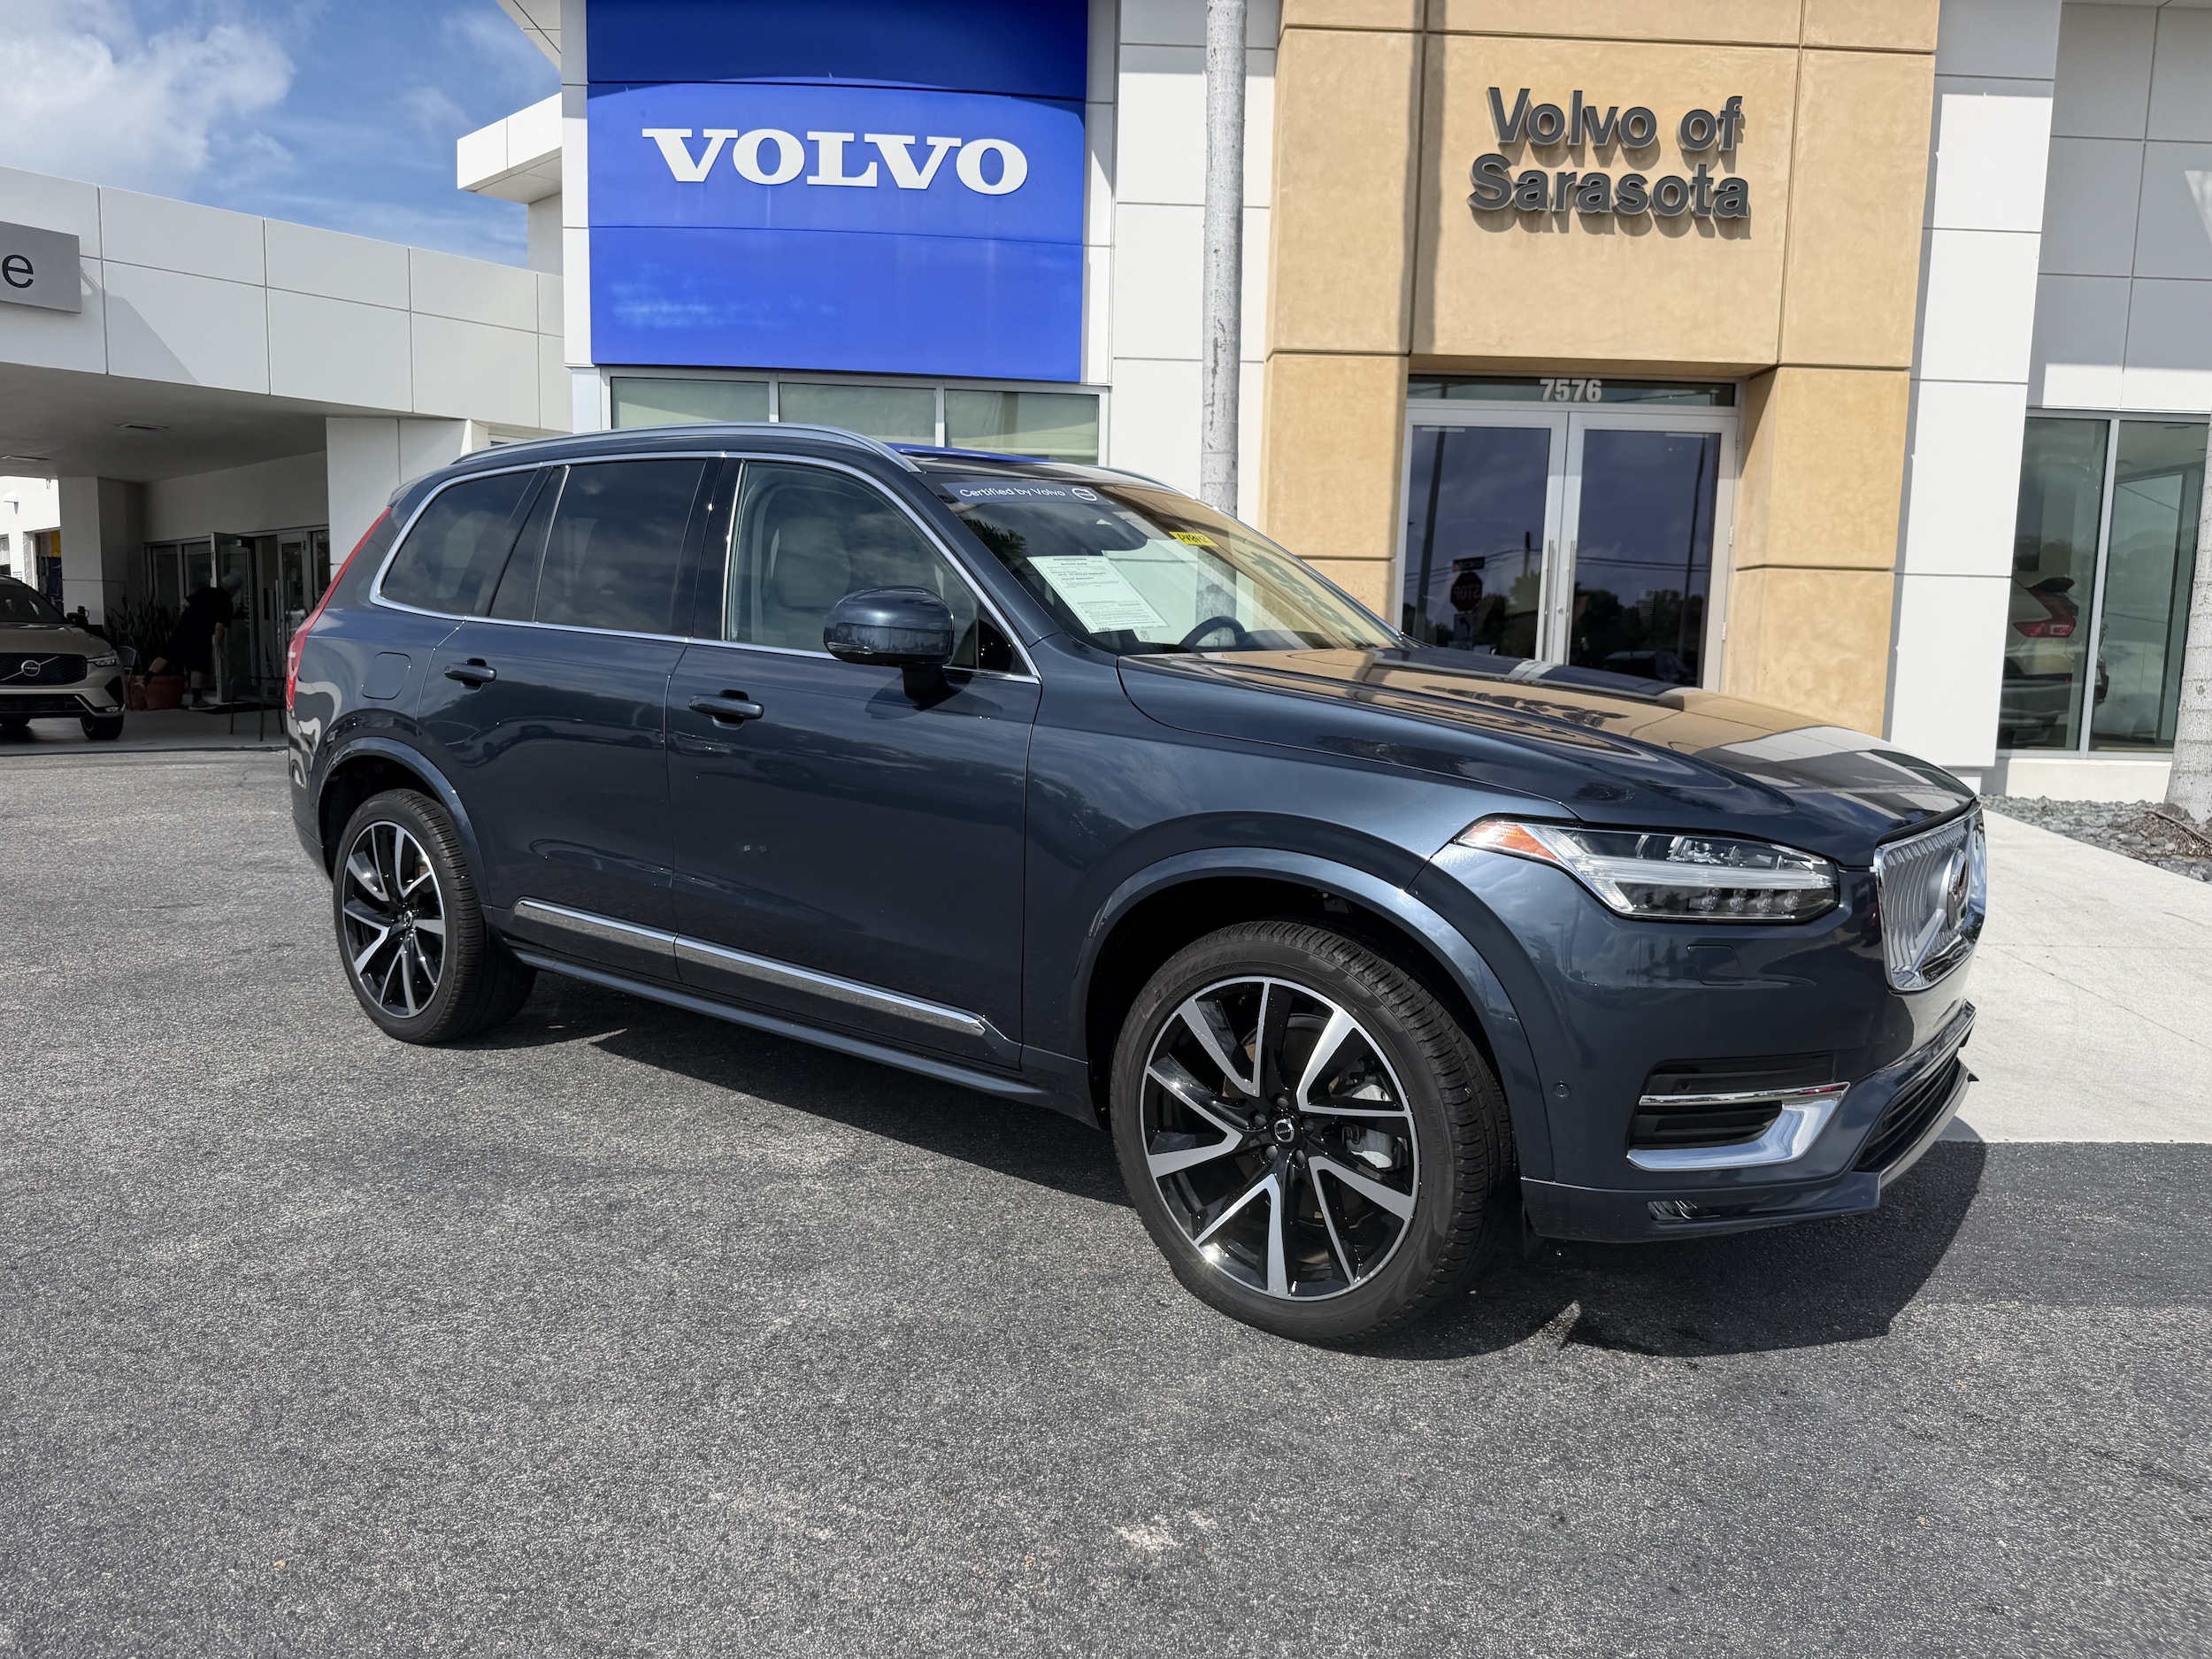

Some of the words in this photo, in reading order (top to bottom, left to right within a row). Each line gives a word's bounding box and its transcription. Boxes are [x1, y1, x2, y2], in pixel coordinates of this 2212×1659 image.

[1486, 87, 1657, 149] Volvo
[1677, 96, 1744, 151] of
[642, 128, 1028, 196] VOLVO
[1466, 153, 1749, 219] Sarasota
[1540, 379, 1602, 403] 7576
[959, 488, 1014, 497] Certified
[1014, 488, 1032, 497] by
[1032, 488, 1066, 496] Volvo
